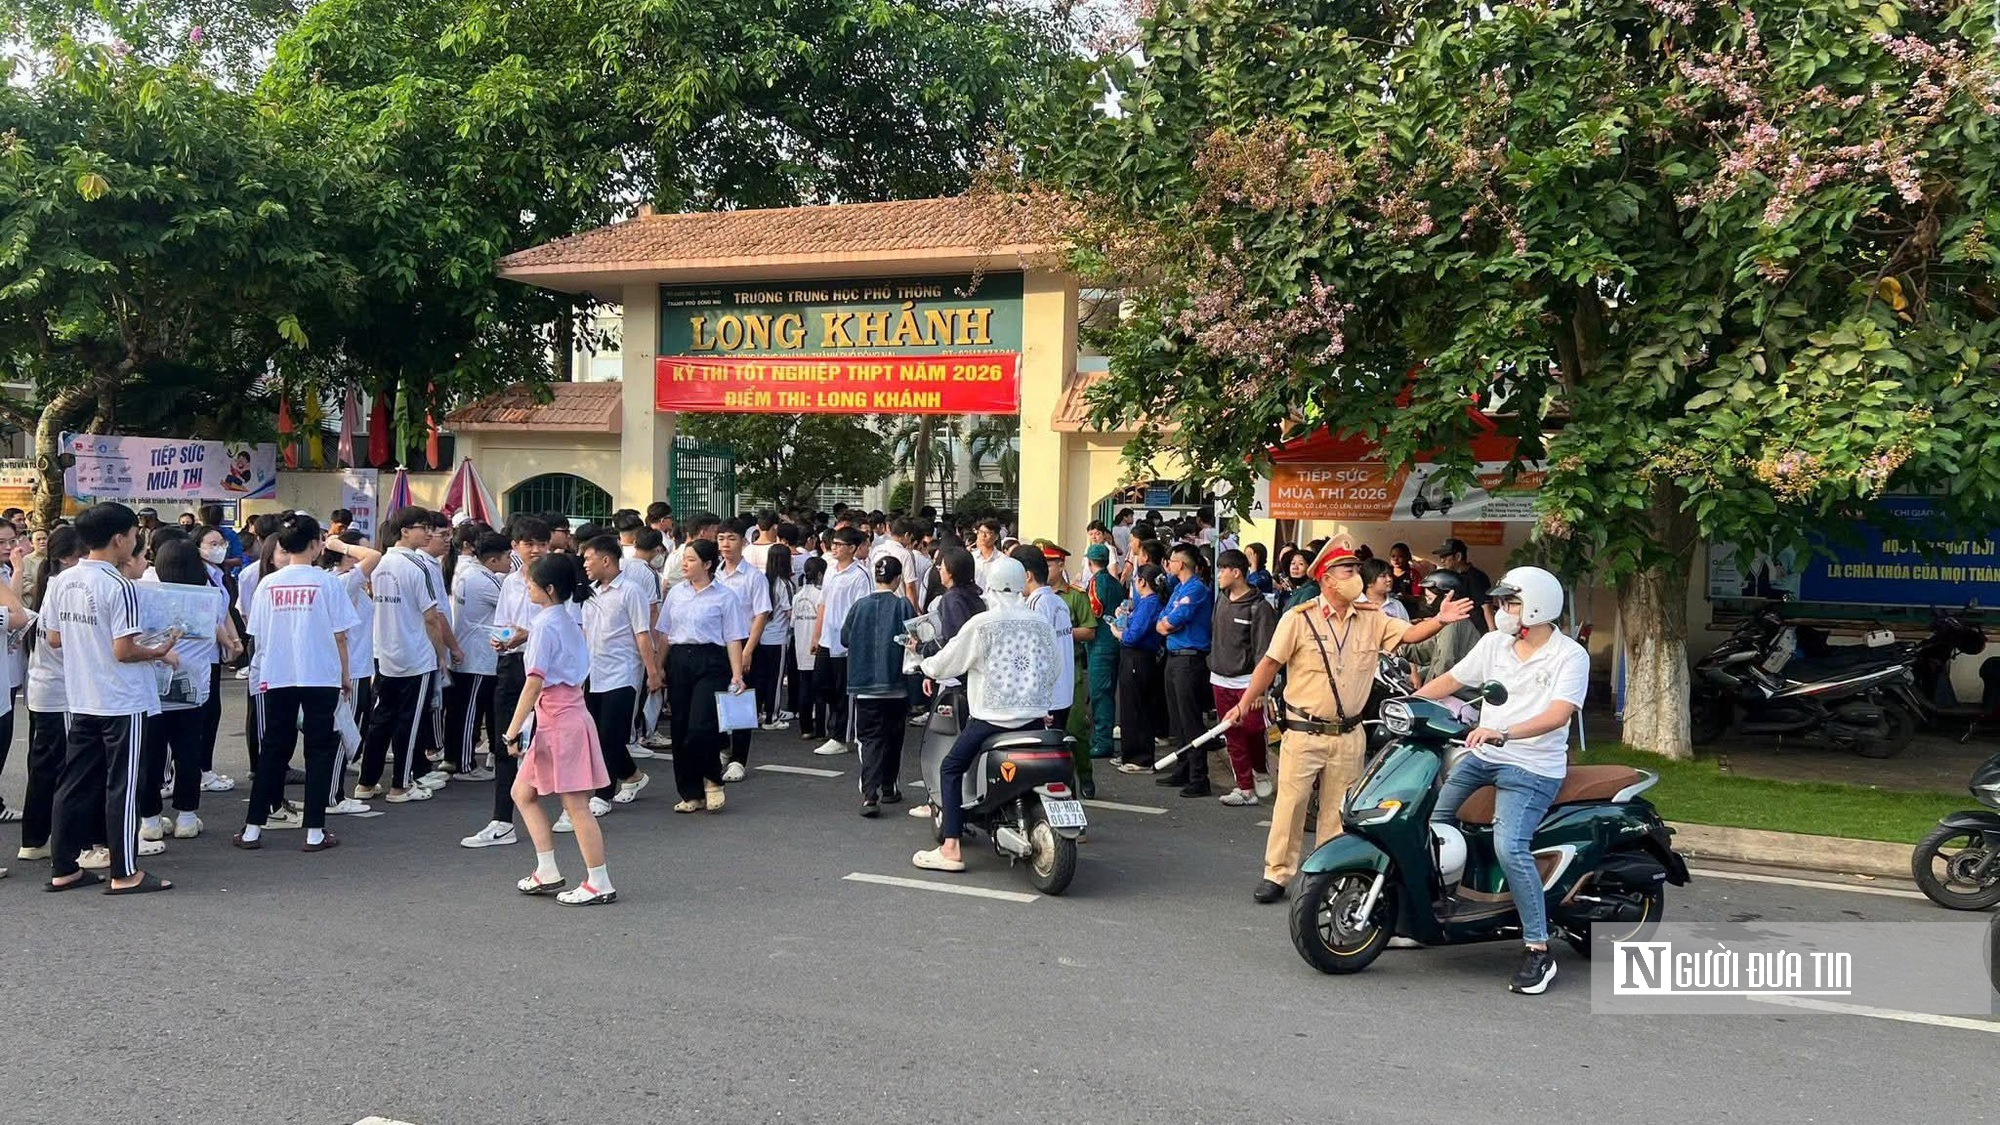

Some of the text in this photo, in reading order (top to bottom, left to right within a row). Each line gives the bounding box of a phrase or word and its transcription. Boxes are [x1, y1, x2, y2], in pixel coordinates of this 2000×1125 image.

[789, 289, 830, 303] TRUNG
[690, 301, 993, 350] LONG KHÁNH
[702, 365, 728, 381] THI
[735, 360, 767, 381] TỐT
[771, 361, 841, 385] NGHIỆP
[847, 365, 893, 381] THPT
[900, 361, 946, 382] NĂM
[952, 365, 1003, 382] 2026
[725, 385, 941, 408] ĐIỂM THI: LONG KHÁNH
[151, 443, 177, 467] TIẾP
[180, 442, 205, 464] SỨC
[147, 467, 178, 491] MÙA
[181, 467, 203, 487] THI
[1278, 485, 1387, 500] MÙA THI 2026
[1941, 567, 1966, 585] MỌI
